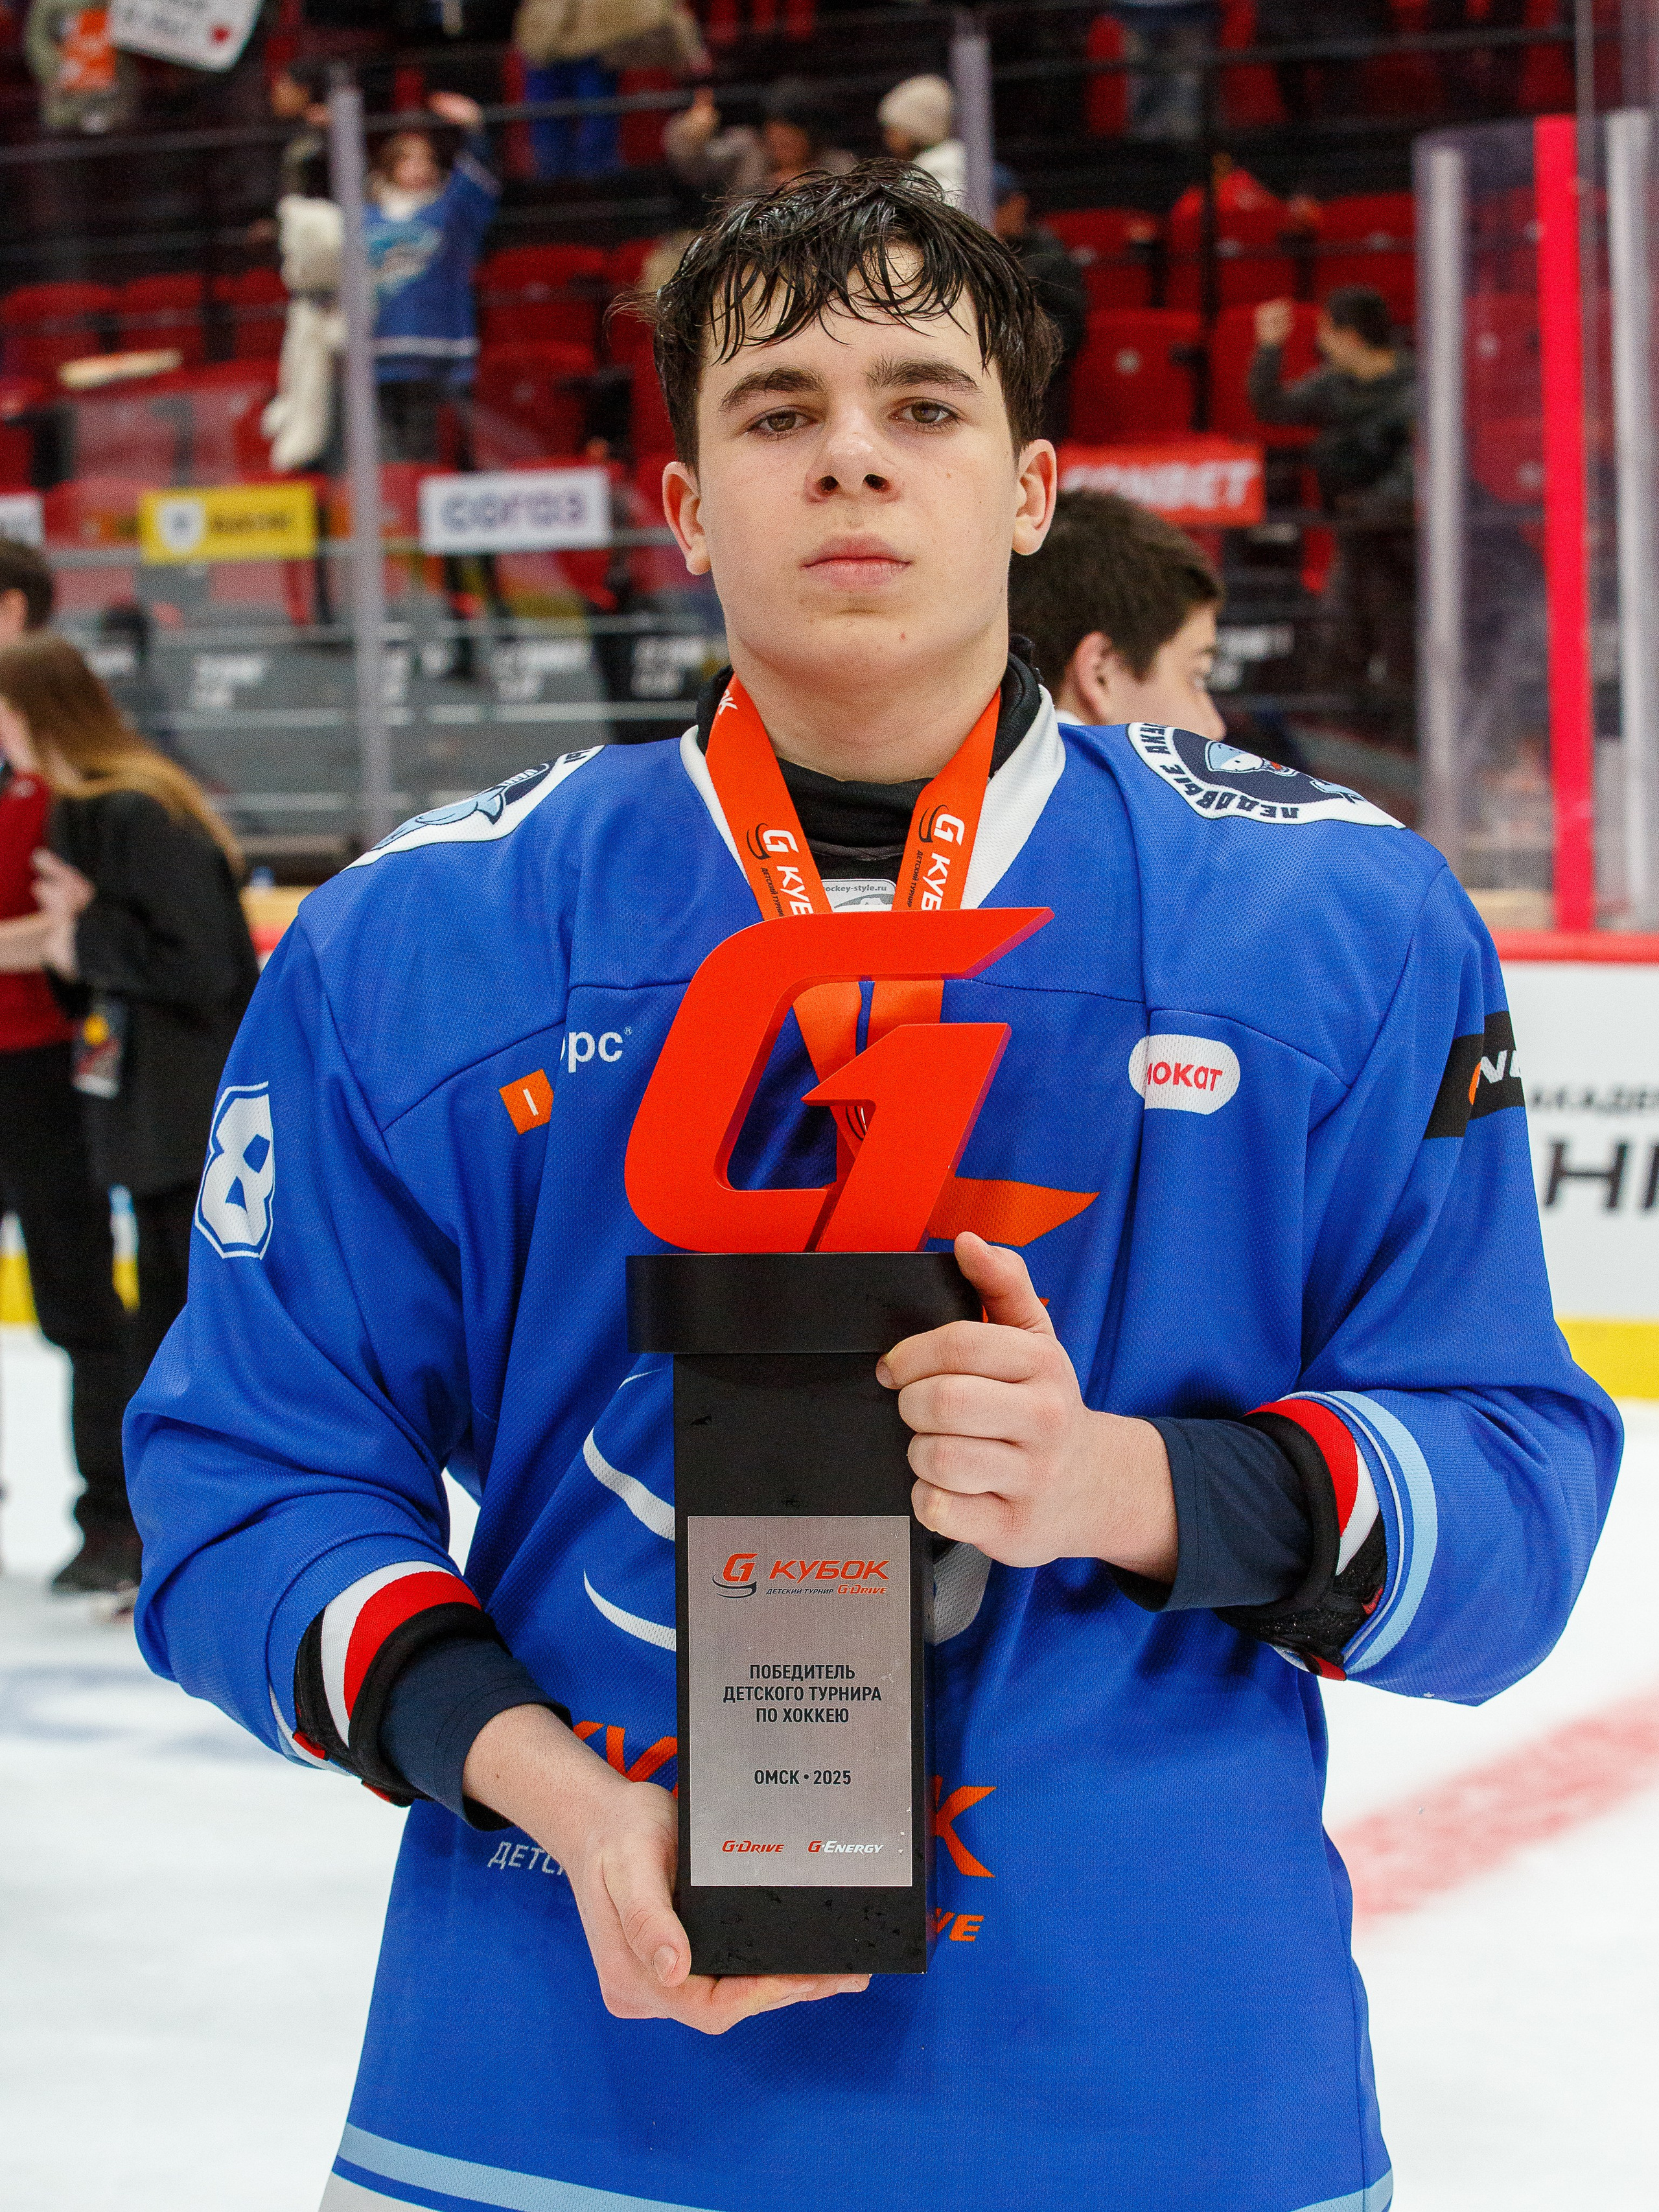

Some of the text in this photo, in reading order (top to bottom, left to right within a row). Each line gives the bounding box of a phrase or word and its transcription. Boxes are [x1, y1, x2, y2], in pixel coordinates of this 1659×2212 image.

[1140, 723, 1171, 755] АКУ
[1529, 1085, 1659, 1117] АКАДЕ
[769, 1560, 890, 1583] КУБОК
[766, 1587, 802, 1595] ДЕТСКИЙ
[749, 1664, 855, 1681] ПОБЕДИТЕЛЬ
[723, 1686, 882, 1703] ДЕТСКОГО ТУРНИРА
[756, 1708, 849, 1723] ПО ХОККЕЮ
[754, 1769, 852, 1785] ОМСК 2025
[487, 1841, 567, 1876] ДЕТС
